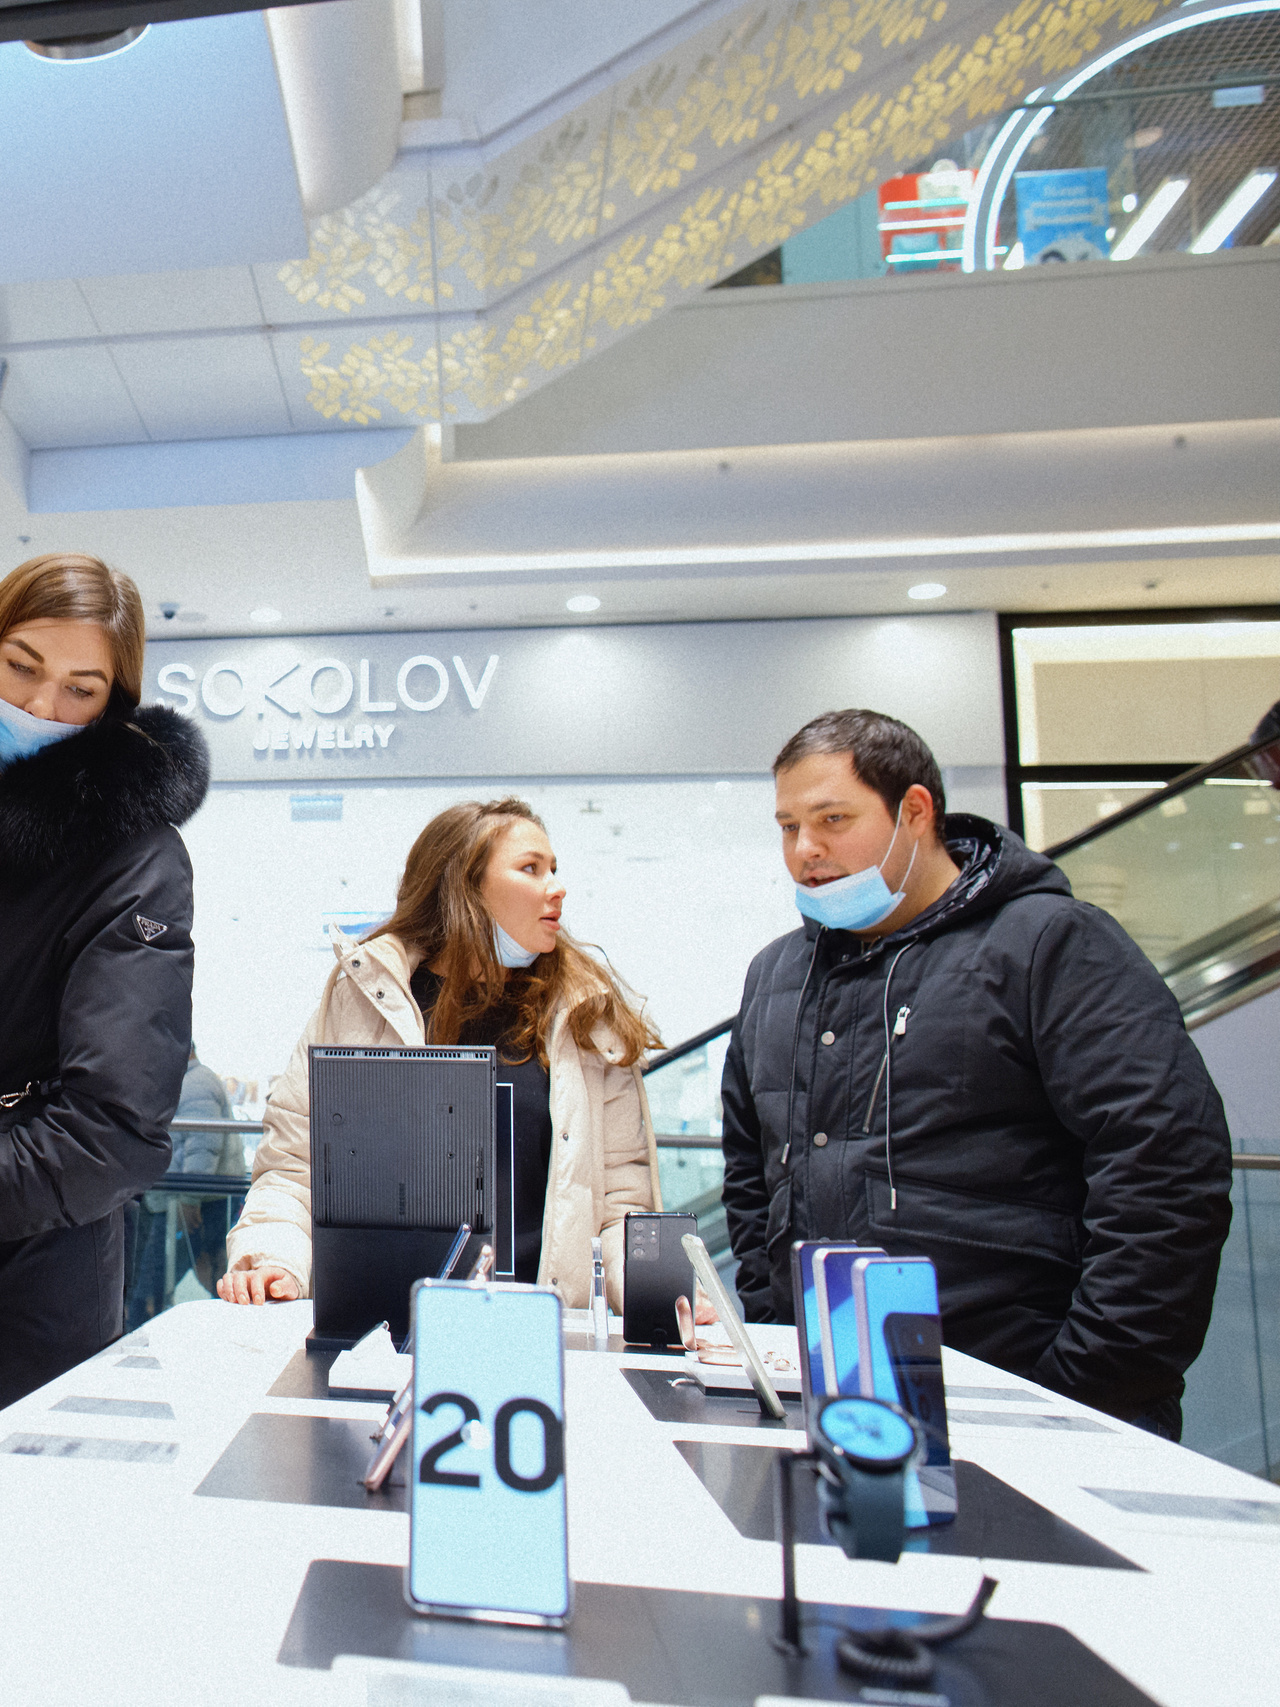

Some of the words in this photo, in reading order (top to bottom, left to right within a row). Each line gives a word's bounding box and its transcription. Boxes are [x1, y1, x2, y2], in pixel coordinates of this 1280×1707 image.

[155, 654, 500, 716] SOKOLOV
[252, 723, 396, 751] JEWELRY
[419, 1392, 565, 1493] 20
